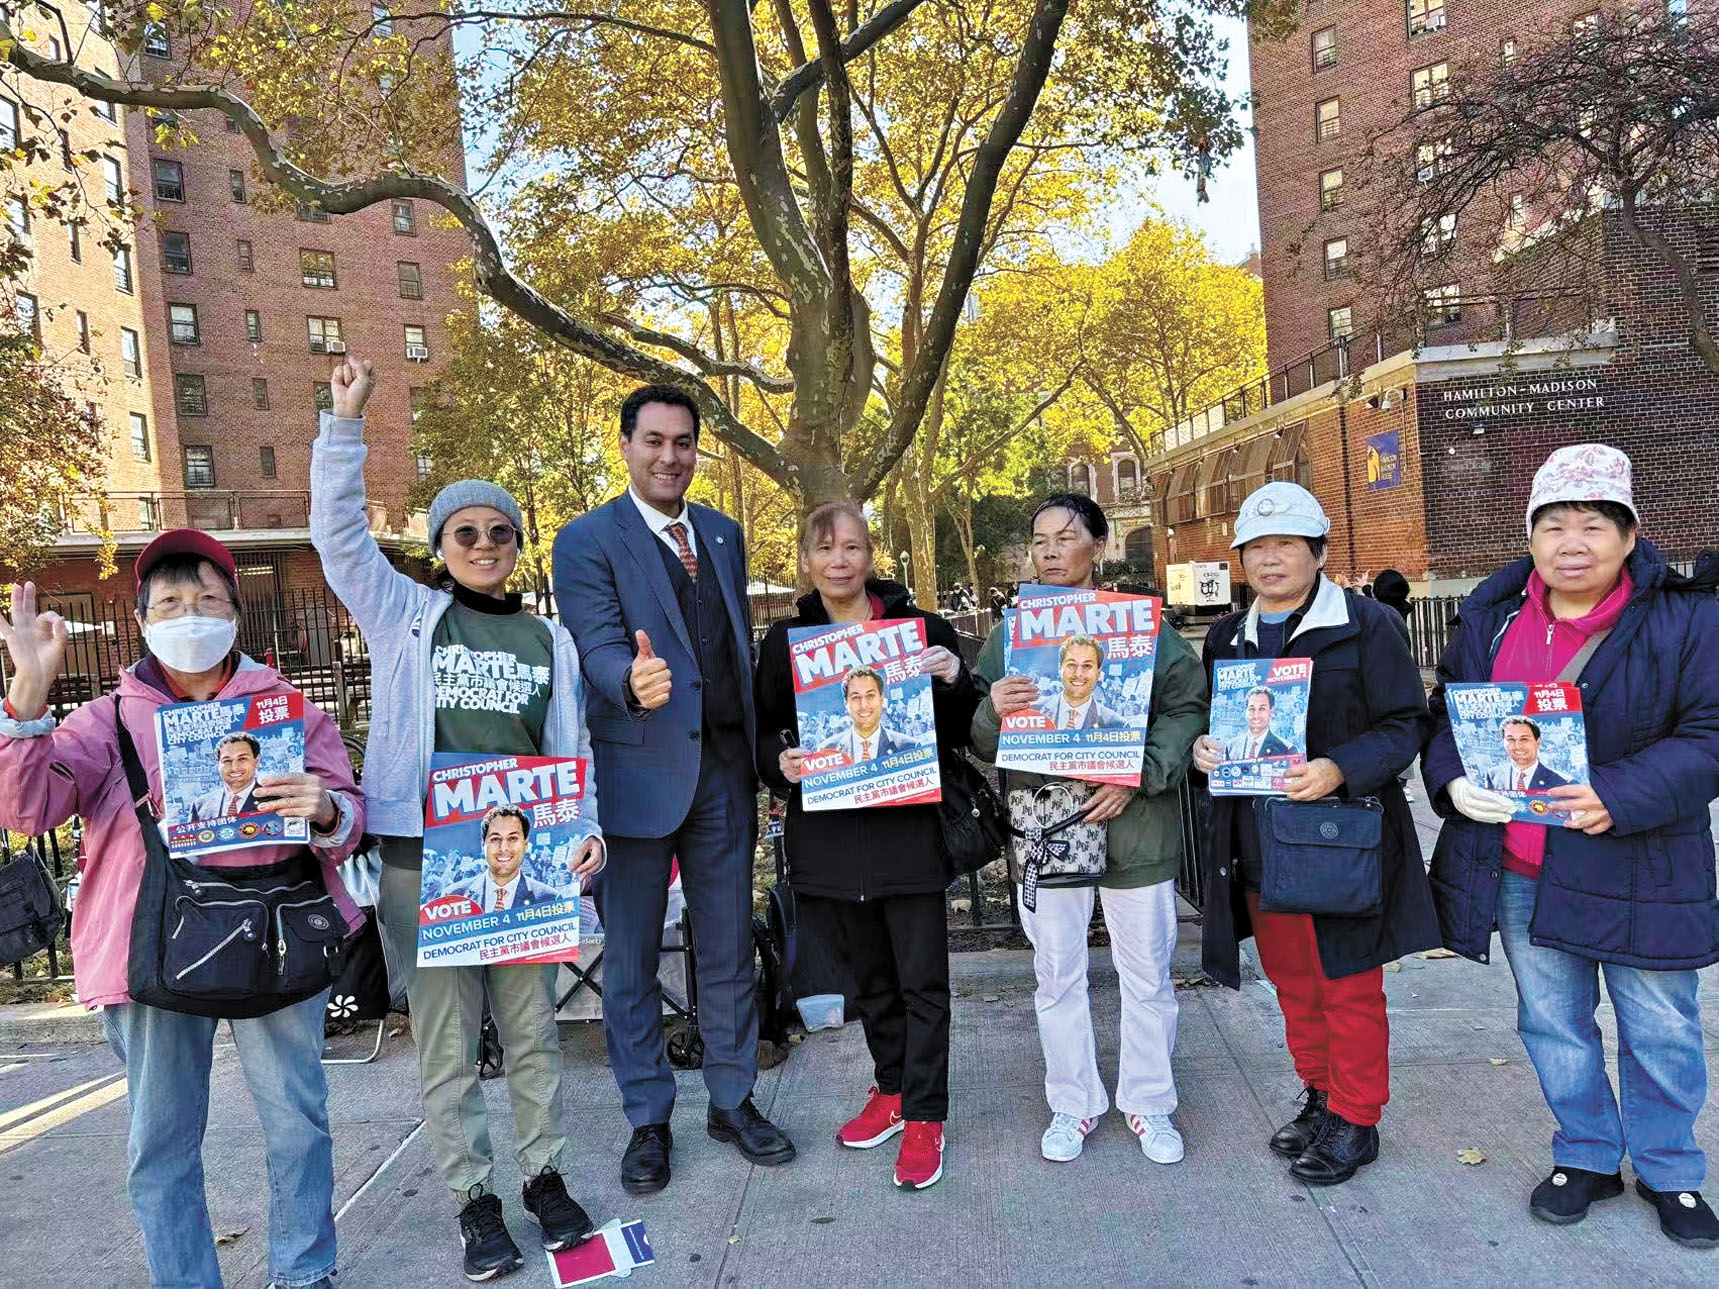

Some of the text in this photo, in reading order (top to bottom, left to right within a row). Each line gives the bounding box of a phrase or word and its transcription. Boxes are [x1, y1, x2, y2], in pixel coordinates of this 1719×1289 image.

[1443, 378, 1597, 402] HAMILTON-MADISON
[1445, 396, 1604, 420] COMMUNITY CENTER
[1020, 593, 1096, 610] CHRISTOPHER
[1021, 599, 1155, 641] MARTE
[792, 623, 865, 654] CHRISTOPHER
[1107, 635, 1153, 660] 馬泰
[434, 644, 517, 663] CHRIOPHER
[795, 621, 923, 684] MARTE
[432, 651, 550, 685] MARTE 馬泰
[884, 655, 923, 685] 馬泰
[1217, 667, 1256, 681] MARTE
[1272, 664, 1306, 677] VOTE
[1267, 674, 1301, 683] NOVEMBER
[256, 696, 288, 709] 11月4日
[507, 691, 529, 705] FOR
[1454, 692, 1501, 704] MARTE
[1533, 689, 1565, 699] 11月4日
[436, 696, 520, 714] ITY COUNCIL
[1536, 698, 1568, 711] 投票
[163, 708, 221, 726] MARTE
[258, 705, 290, 724] 投票
[1005, 716, 1047, 729] VOTE
[188, 731, 225, 742] COUNCIL
[1002, 731, 1141, 745] NOVEMBER 4 11月4日投票
[802, 753, 843, 772] VOTE
[1001, 750, 1141, 762] DEMOCRAT FOR CITY COUNCIL
[433, 758, 518, 782] CHRISTOPHER
[804, 748, 934, 789] NOVEMBER 4 11月4日投票
[435, 761, 580, 817] MARTE
[807, 767, 937, 805] DEMOCRAT FOR CITY COUNCIL
[533, 799, 580, 829] 馬泰
[424, 900, 472, 921] VOTE
[422, 917, 499, 940] NOVEMBER
[502, 914, 511, 924] 4
[517, 902, 575, 921] 11月4日投票
[423, 922, 577, 960] DEMOCRAT FOR CITY COUNCIL
[480, 933, 571, 961] 民主黨市議會候選人
